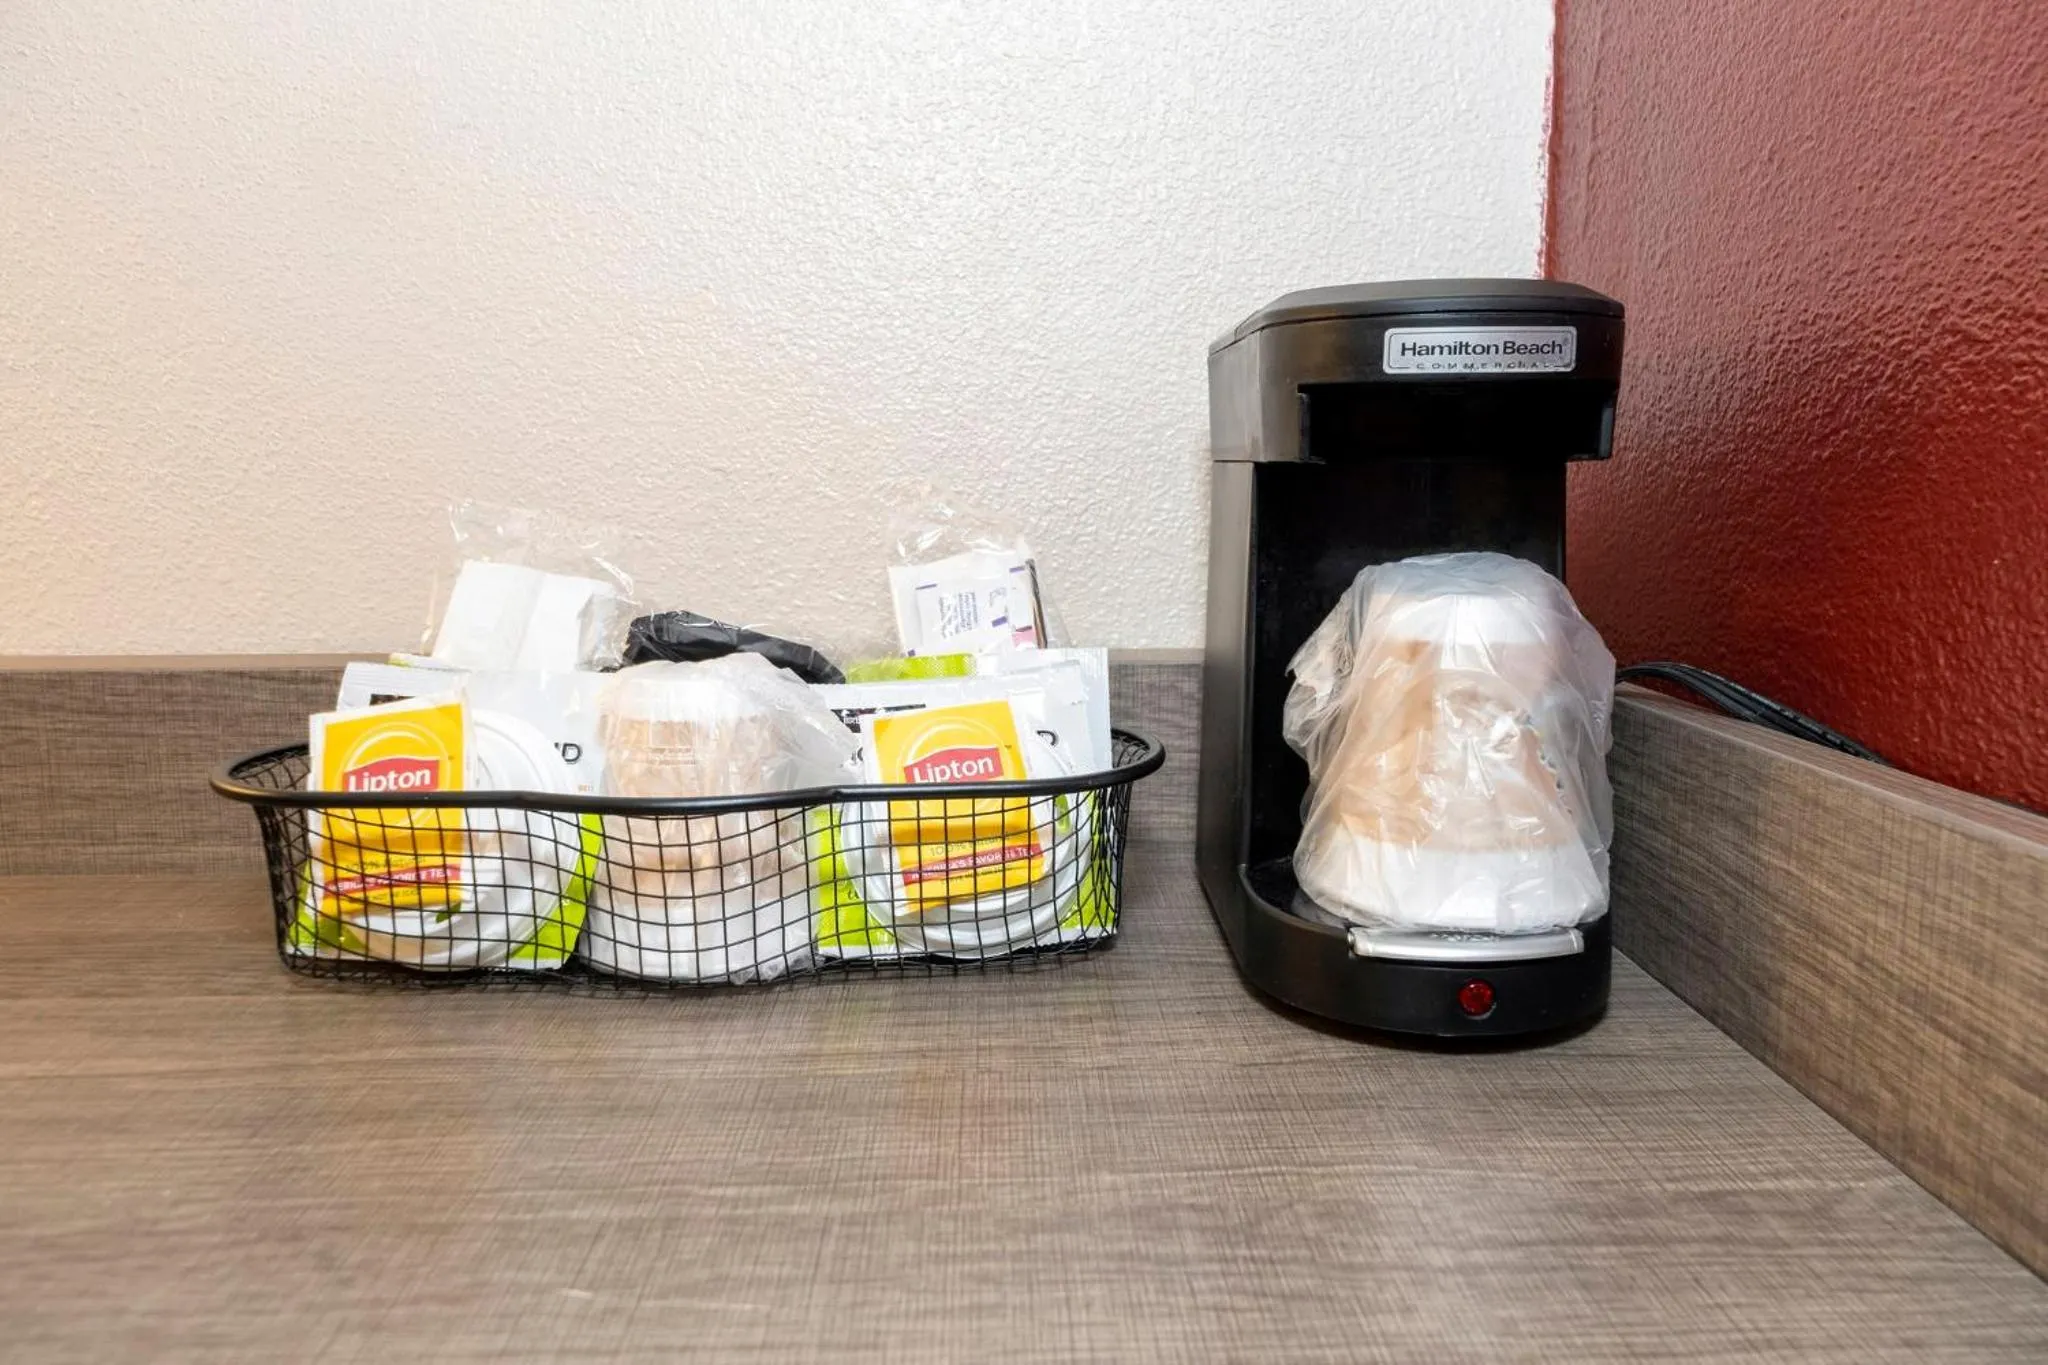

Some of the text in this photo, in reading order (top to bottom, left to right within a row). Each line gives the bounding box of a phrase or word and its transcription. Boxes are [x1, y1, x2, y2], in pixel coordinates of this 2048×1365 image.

[1401, 340, 1563, 357] Hamilton Beach
[348, 768, 431, 792] Lipton
[911, 756, 996, 784] Lipton
